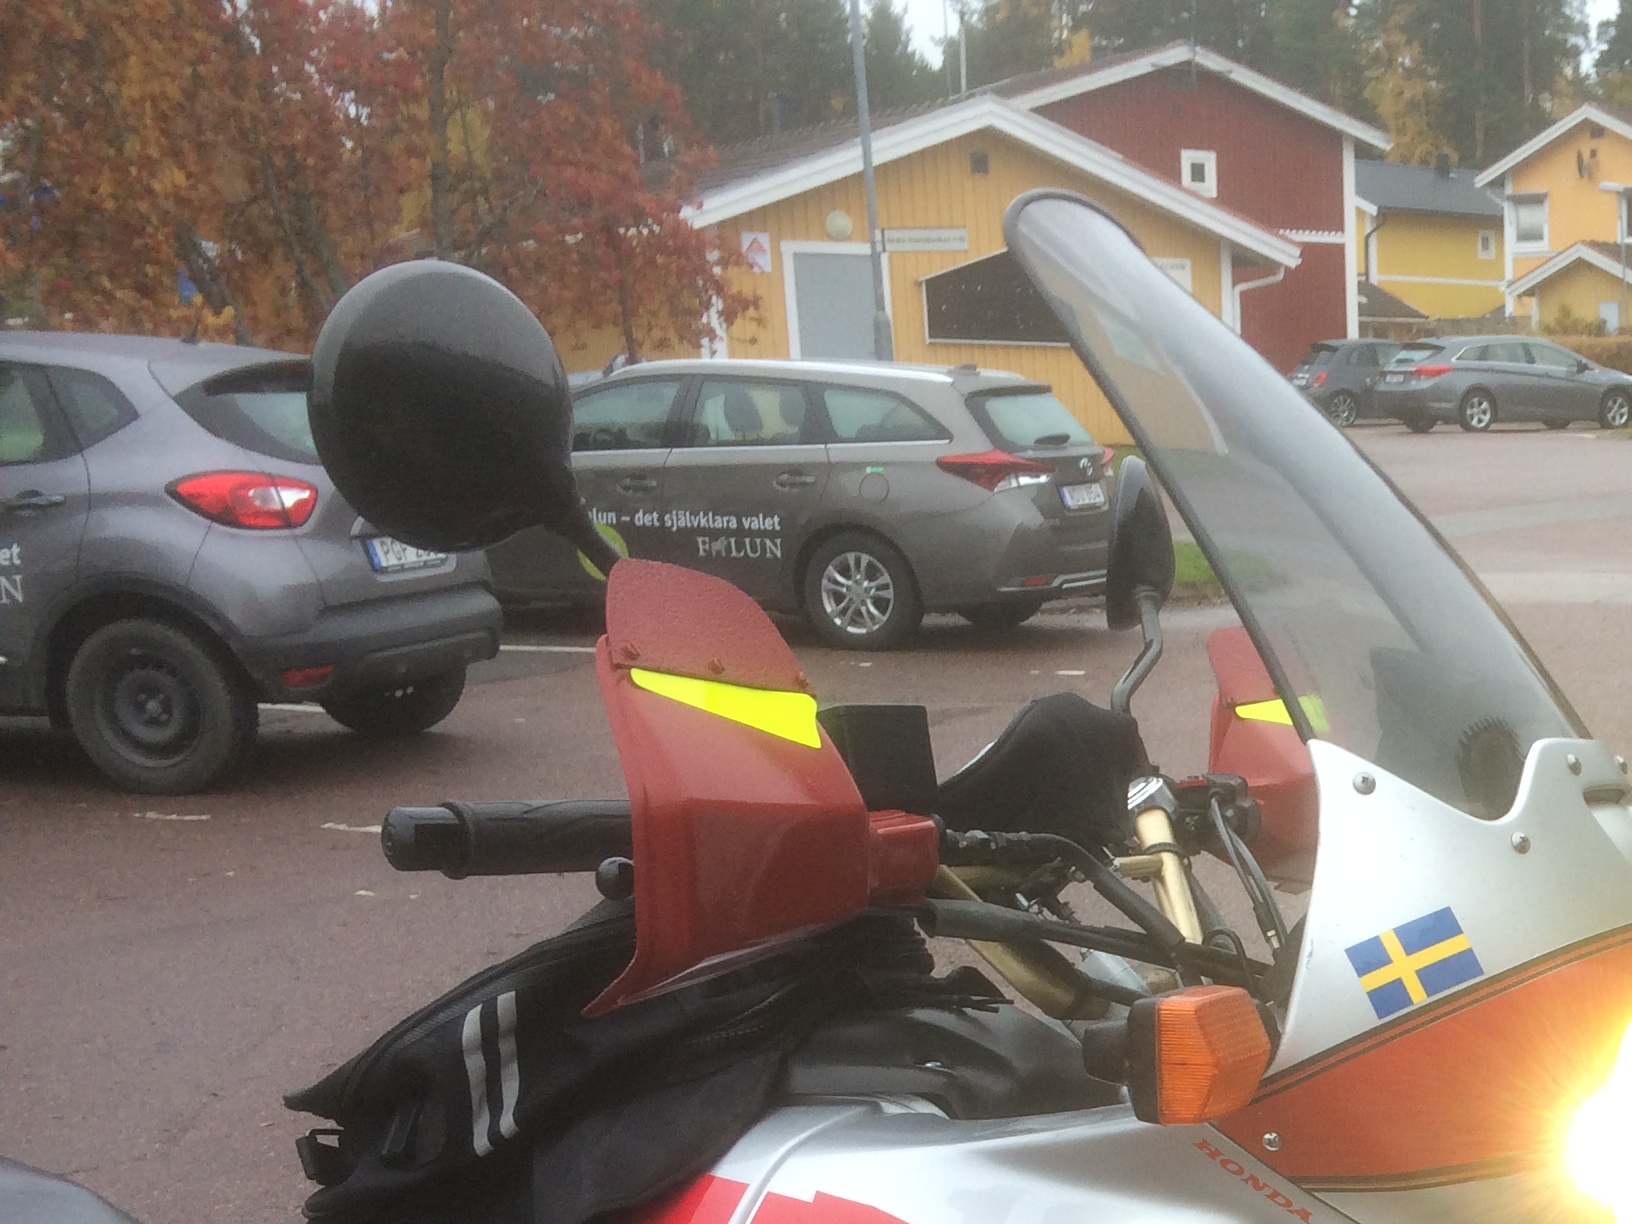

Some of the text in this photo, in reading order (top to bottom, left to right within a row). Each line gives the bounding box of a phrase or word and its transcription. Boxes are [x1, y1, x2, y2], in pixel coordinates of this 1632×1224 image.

[584, 502, 616, 525] lun
[634, 508, 660, 527] det
[663, 510, 738, 532] självklara
[742, 513, 781, 530] valet
[696, 536, 782, 559] FLUN
[1194, 1139, 1313, 1224] HONDA
